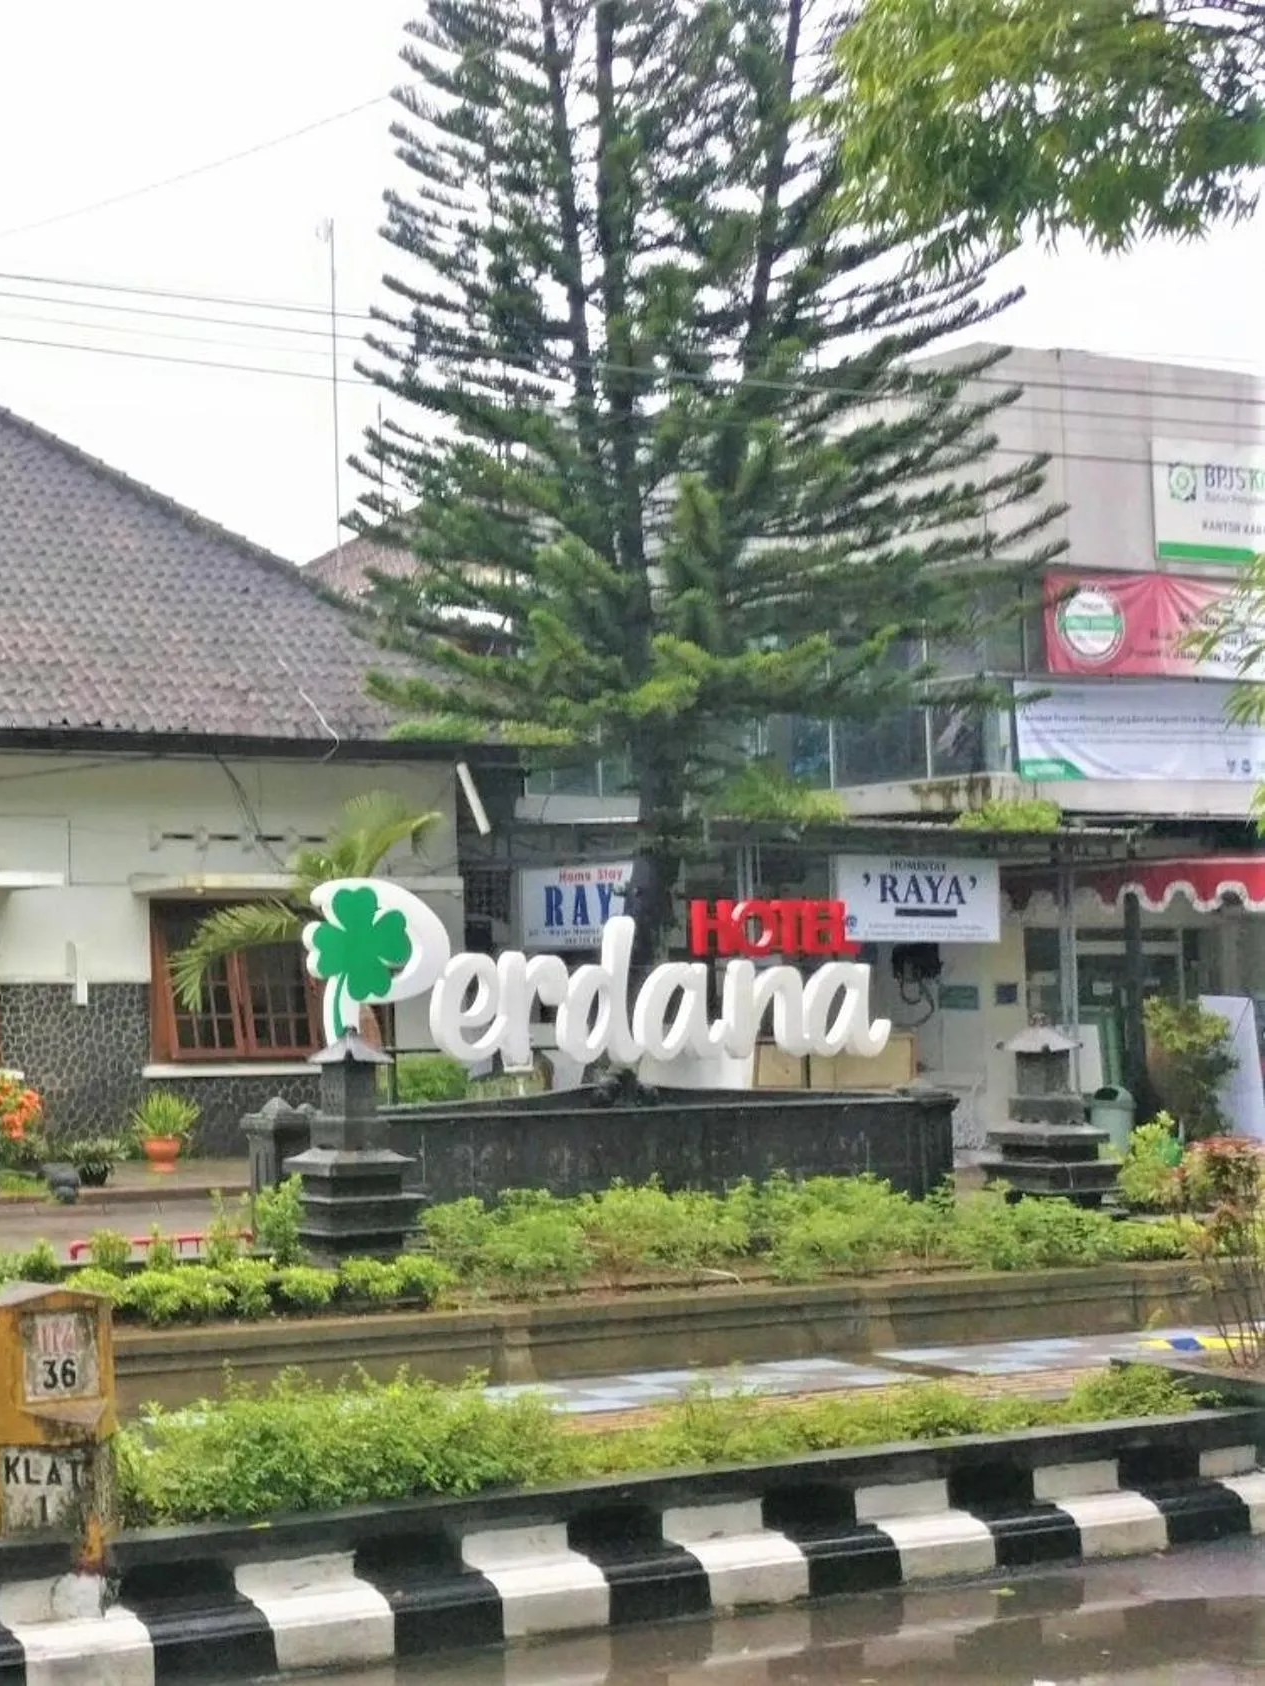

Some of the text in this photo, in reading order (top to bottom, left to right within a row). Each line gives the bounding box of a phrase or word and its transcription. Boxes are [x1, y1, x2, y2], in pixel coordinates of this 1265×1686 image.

[1204, 464, 1246, 490] BPJS
[544, 883, 615, 927] RAY
[690, 898, 862, 956] HOTEL
[302, 876, 892, 1066] Perdana
[42, 1358, 77, 1389] 36
